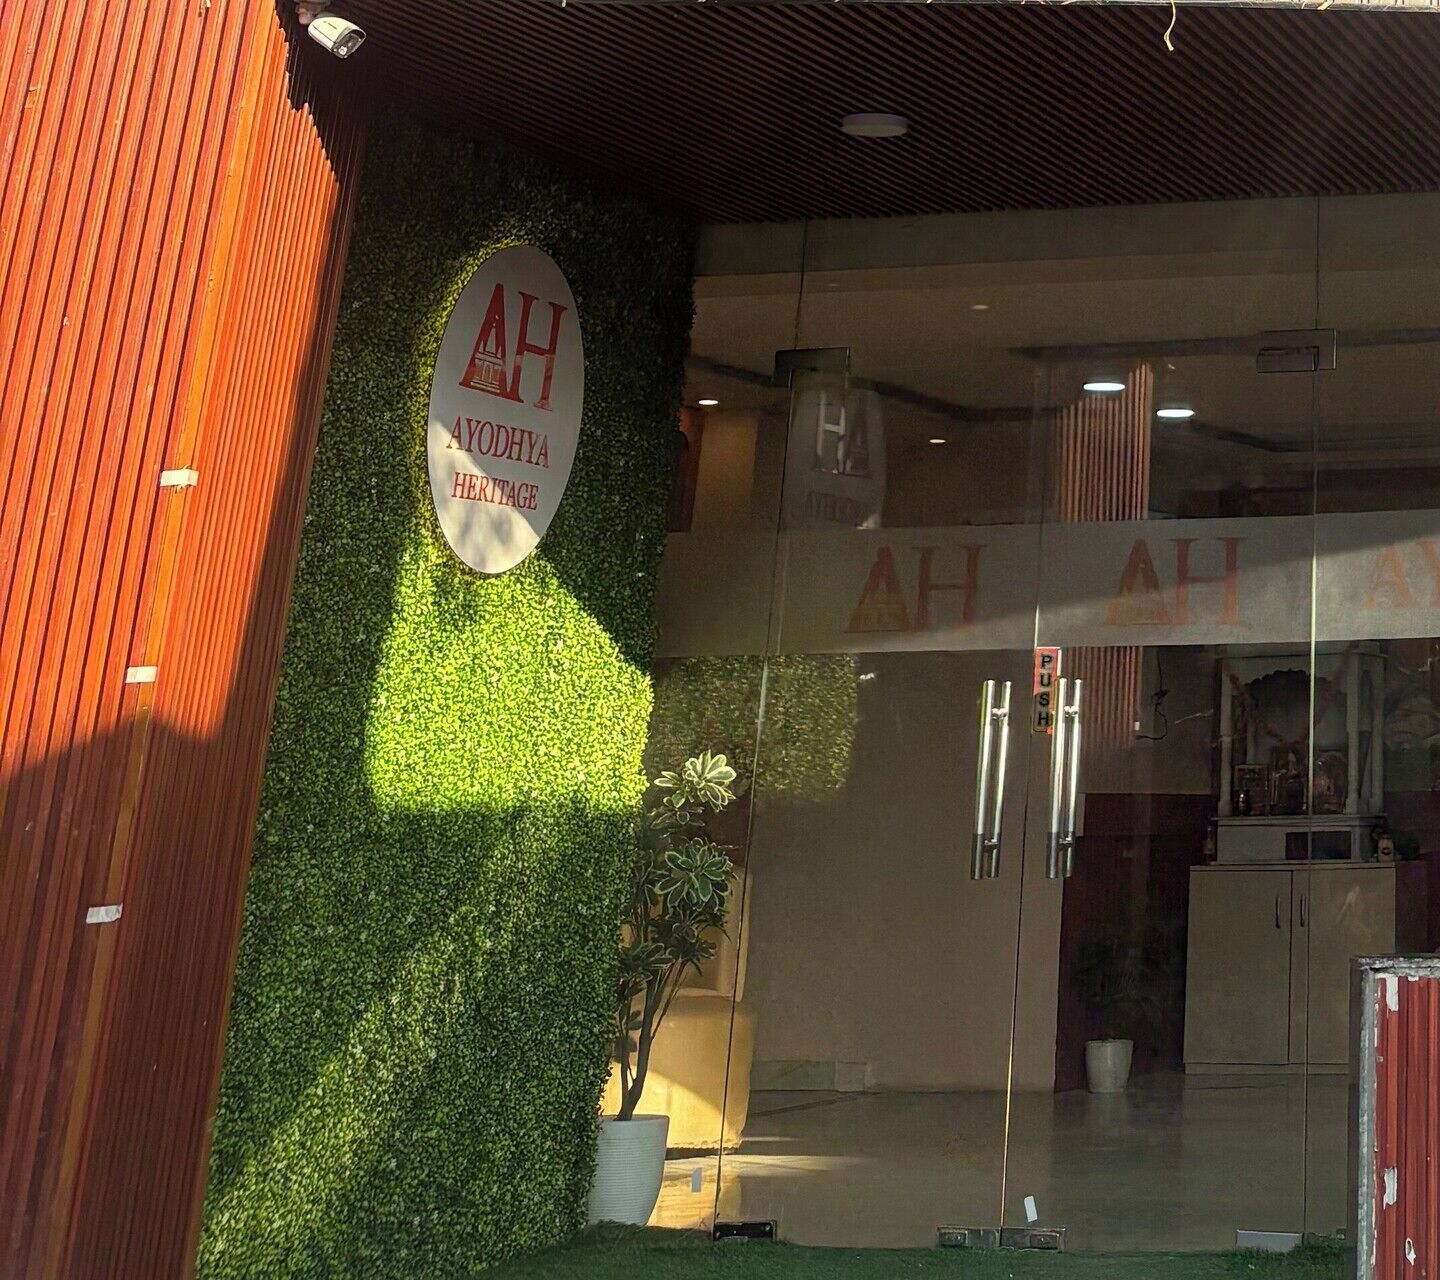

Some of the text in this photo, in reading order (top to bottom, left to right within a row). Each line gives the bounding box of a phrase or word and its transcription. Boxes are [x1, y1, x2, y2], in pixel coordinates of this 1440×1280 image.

[458, 282, 569, 411] AH
[445, 415, 550, 469] AYODHYA
[451, 471, 539, 512] HERITAGE
[844, 542, 988, 634] AH
[1102, 535, 1250, 628] AH
[1038, 654, 1053, 727] PUSH
